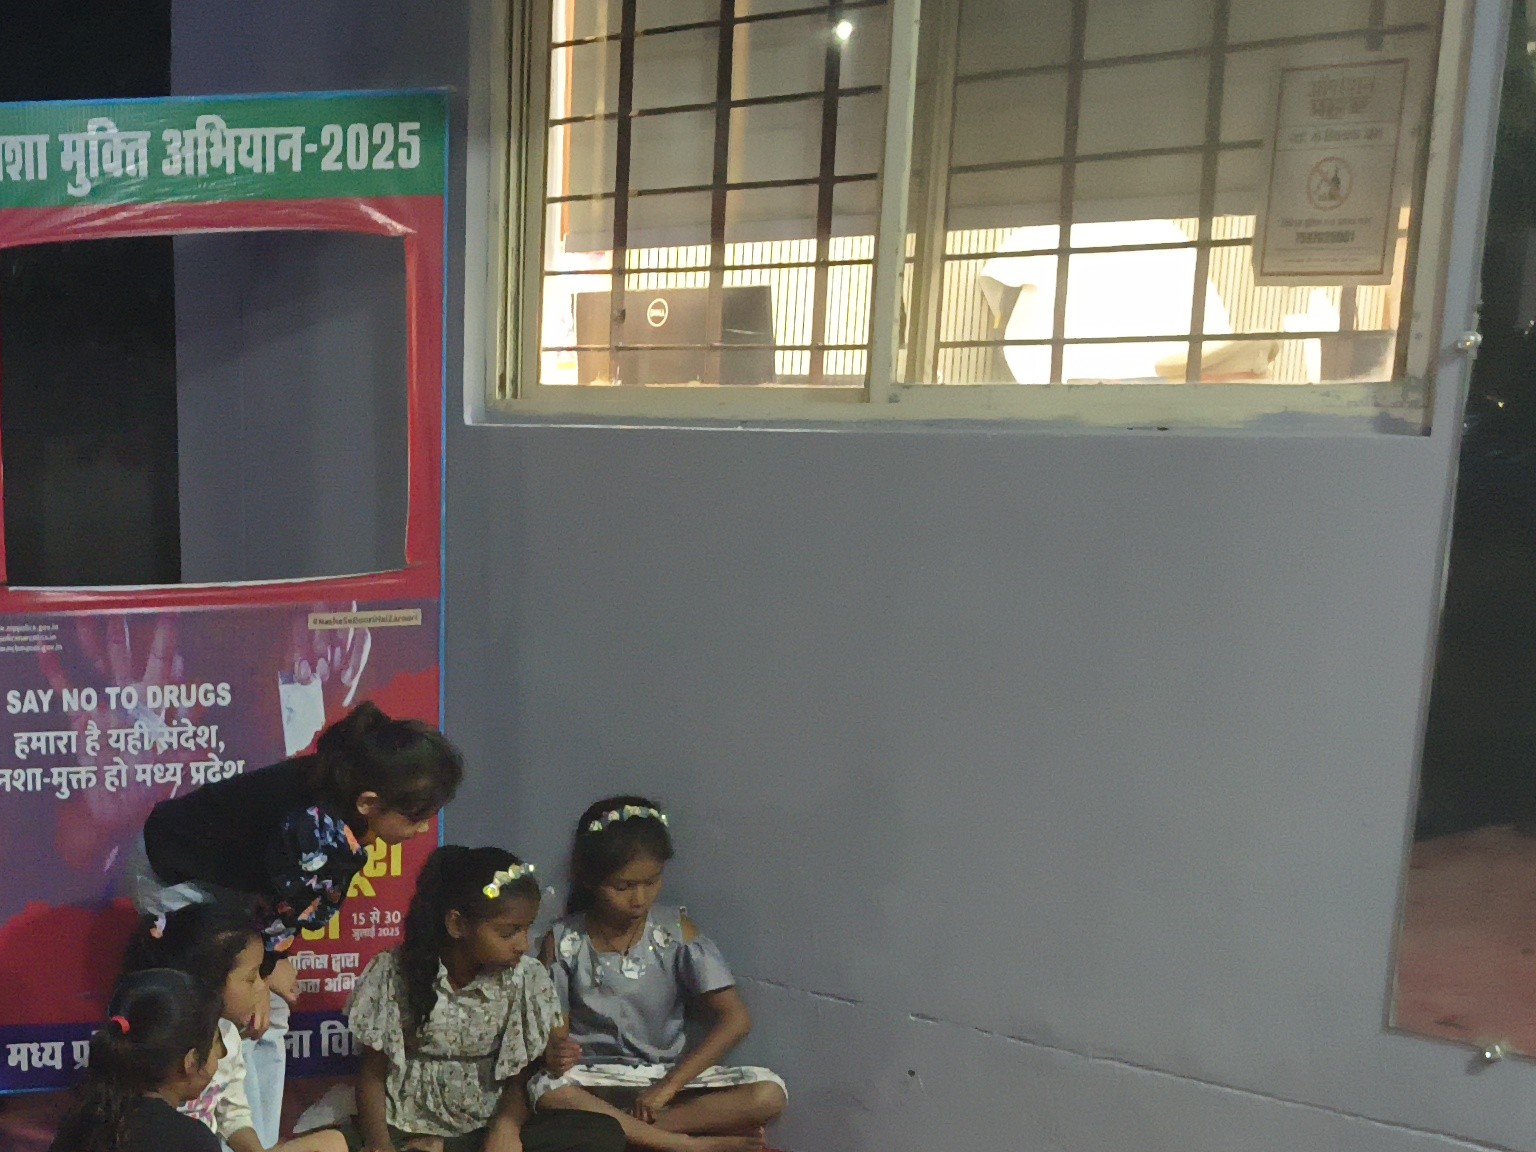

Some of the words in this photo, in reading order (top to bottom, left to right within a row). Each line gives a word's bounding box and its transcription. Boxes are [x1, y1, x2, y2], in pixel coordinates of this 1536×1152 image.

[57, 116, 152, 197] मुक्ति
[161, 113, 421, 178] अभियान-2025
[6, 689, 54, 715] SAY
[61, 687, 98, 712] NO
[104, 685, 139, 710] TO
[146, 682, 232, 709] DRUGS
[13, 730, 79, 760] हमारा
[83, 719, 102, 757] है
[107, 719, 154, 756] यही
[103, 756, 129, 792] हो
[134, 762, 184, 788] मध्य
[351, 911, 366, 926] 15
[369, 906, 381, 925] से
[384, 910, 402, 925] 30
[377, 926, 401, 938] 2025
[5, 1041, 65, 1073] मध्य
